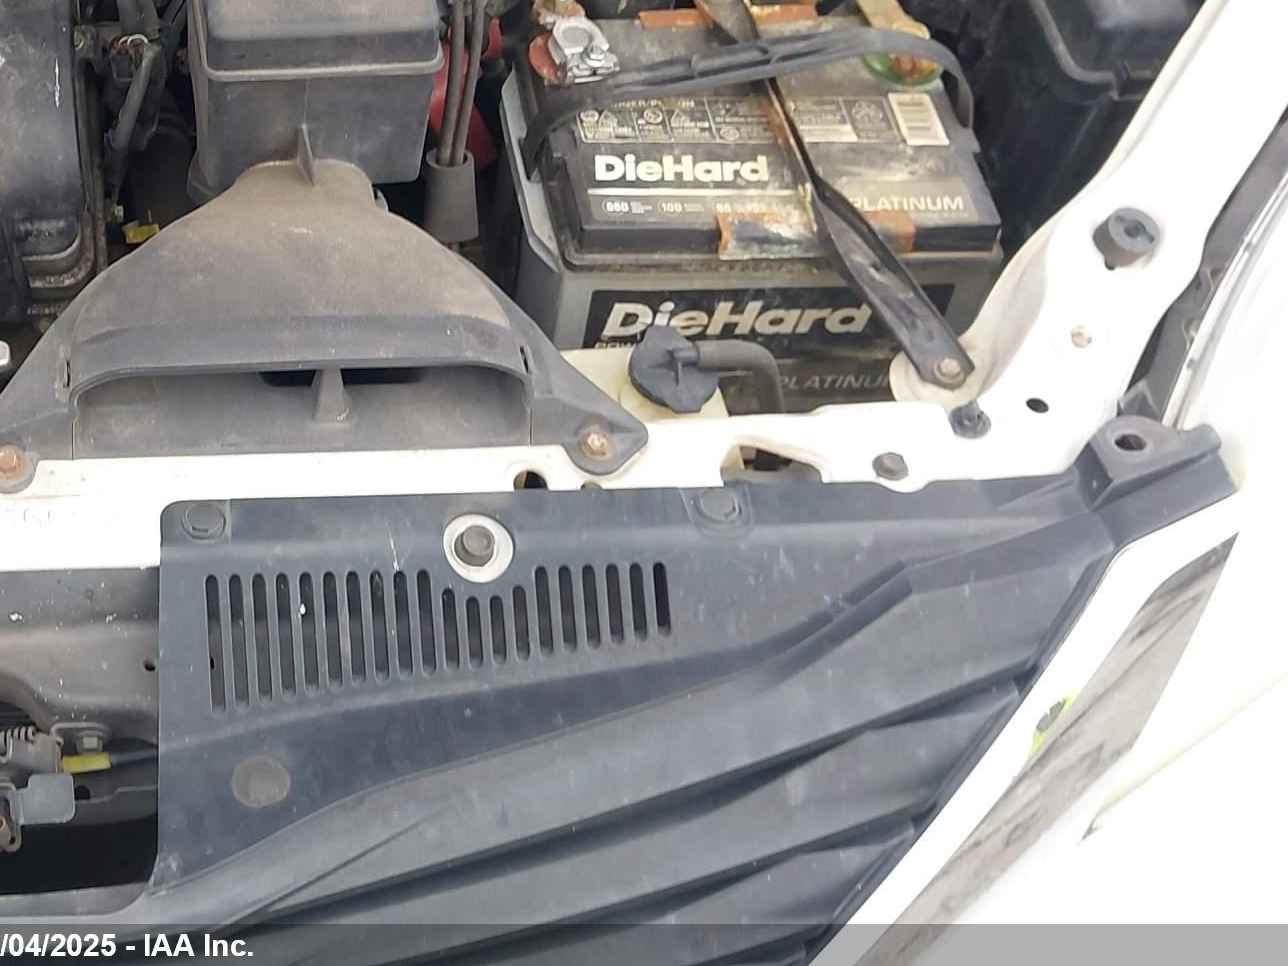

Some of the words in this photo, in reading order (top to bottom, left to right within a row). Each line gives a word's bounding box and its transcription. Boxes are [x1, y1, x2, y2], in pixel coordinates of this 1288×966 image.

[594, 153, 769, 182] DieHard
[601, 300, 873, 337] DieHard
[779, 374, 890, 389] PLATINU
